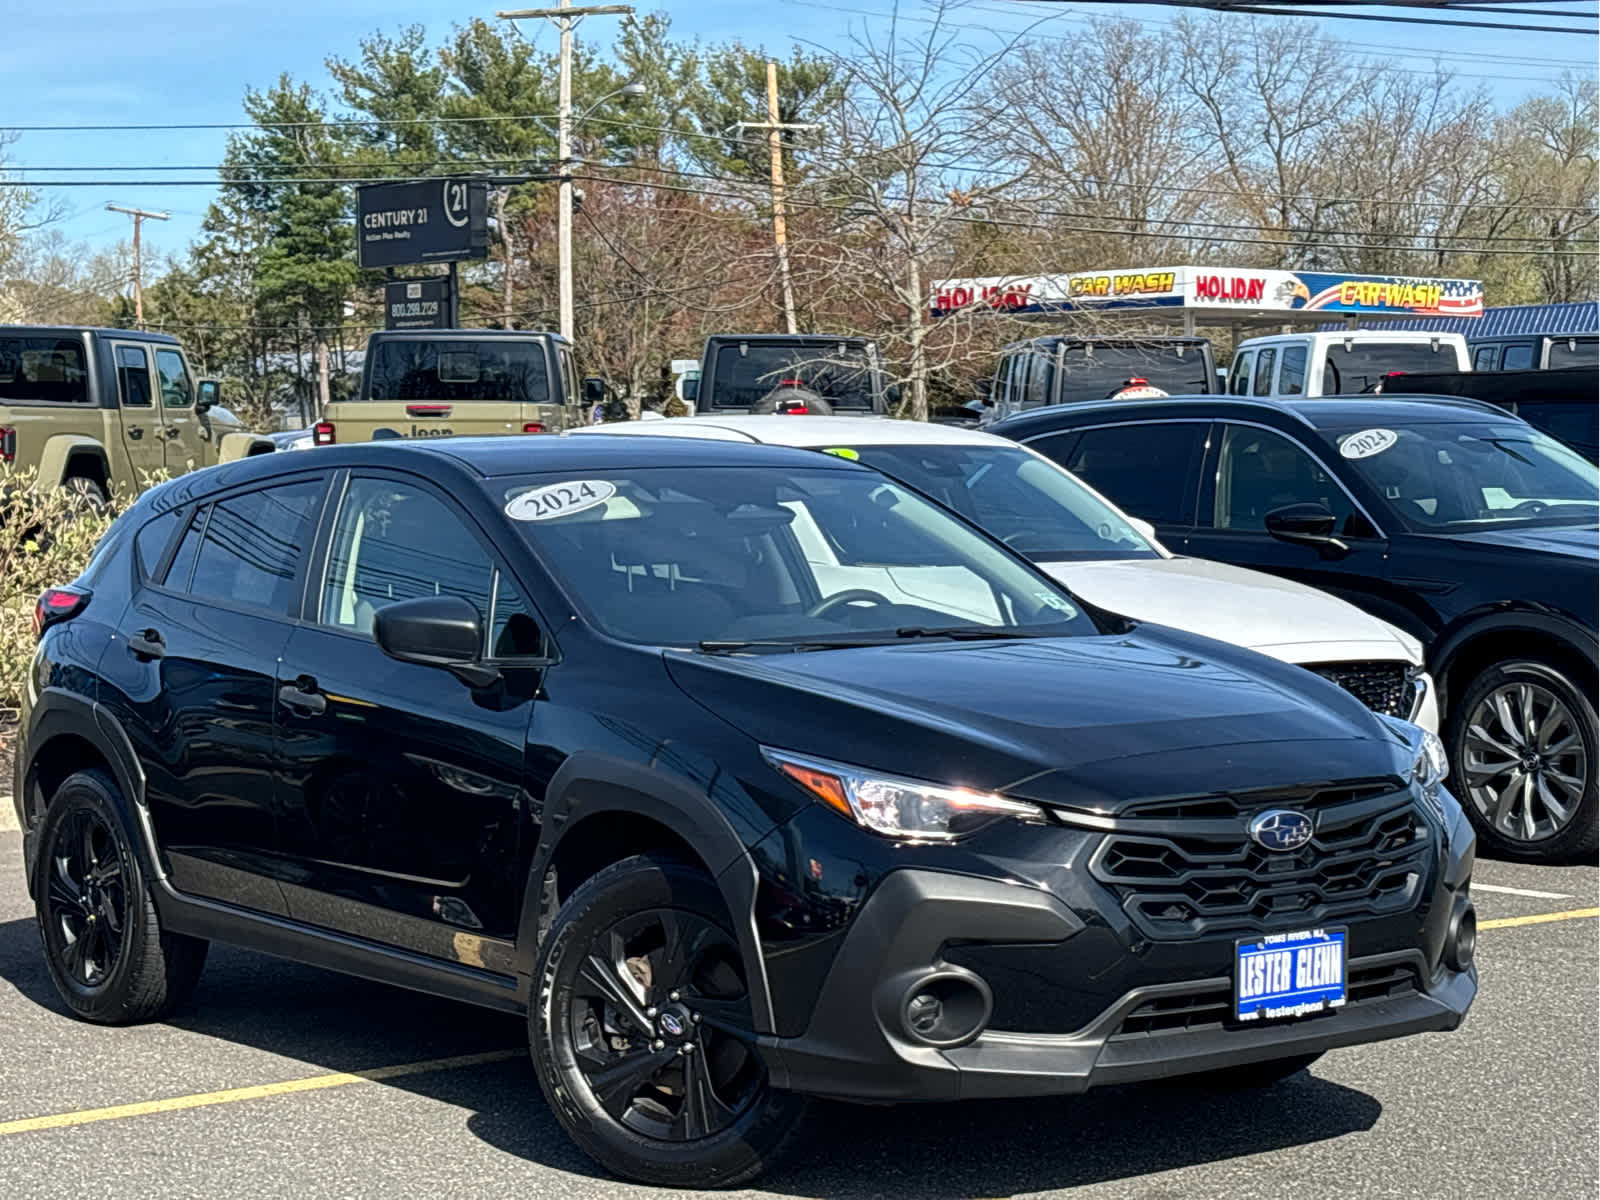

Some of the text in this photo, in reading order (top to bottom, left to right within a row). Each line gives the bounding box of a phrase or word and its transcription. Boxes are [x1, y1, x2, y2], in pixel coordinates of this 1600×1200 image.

[364, 207, 428, 229] CENTURY 21
[1069, 276, 1110, 297] CAR
[1113, 272, 1175, 295] WASH
[1195, 275, 1440, 309] HOLIDAY CAR WASH
[1350, 431, 1389, 455] 2024
[524, 482, 597, 517] 2024
[1239, 943, 1342, 998] LESTER GLENN
